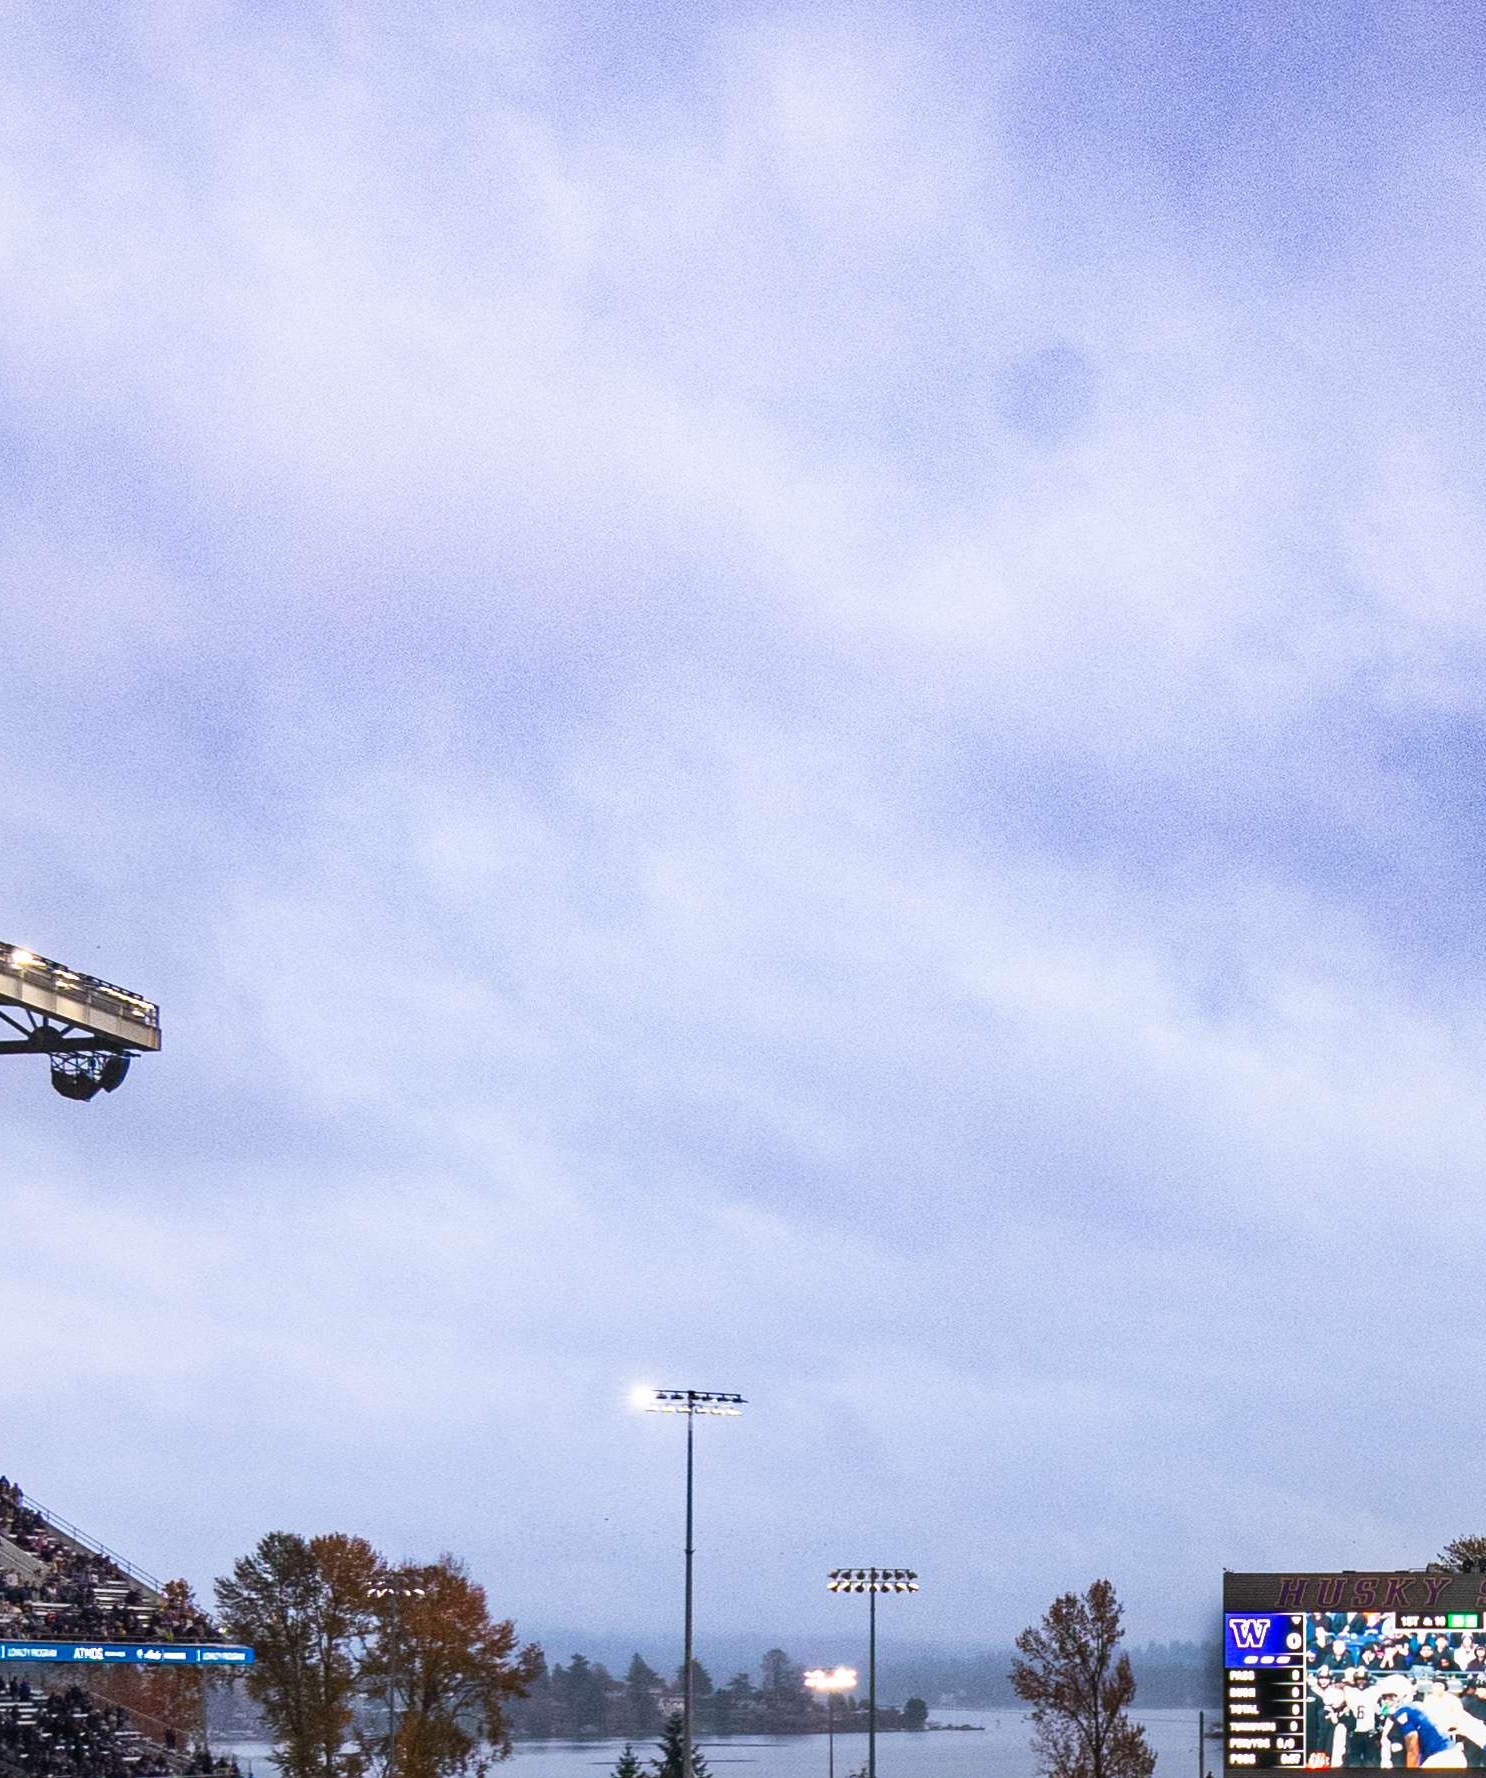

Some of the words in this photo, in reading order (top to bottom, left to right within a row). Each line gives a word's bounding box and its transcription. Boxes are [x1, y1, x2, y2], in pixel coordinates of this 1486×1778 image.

[1276, 1577, 1452, 1608] HUSKY
[1400, 1616, 1421, 1627] 1ST
[1229, 1618, 1271, 1649] W
[1286, 1632, 1302, 1650] 0
[1357, 1705, 1365, 1720] 6
